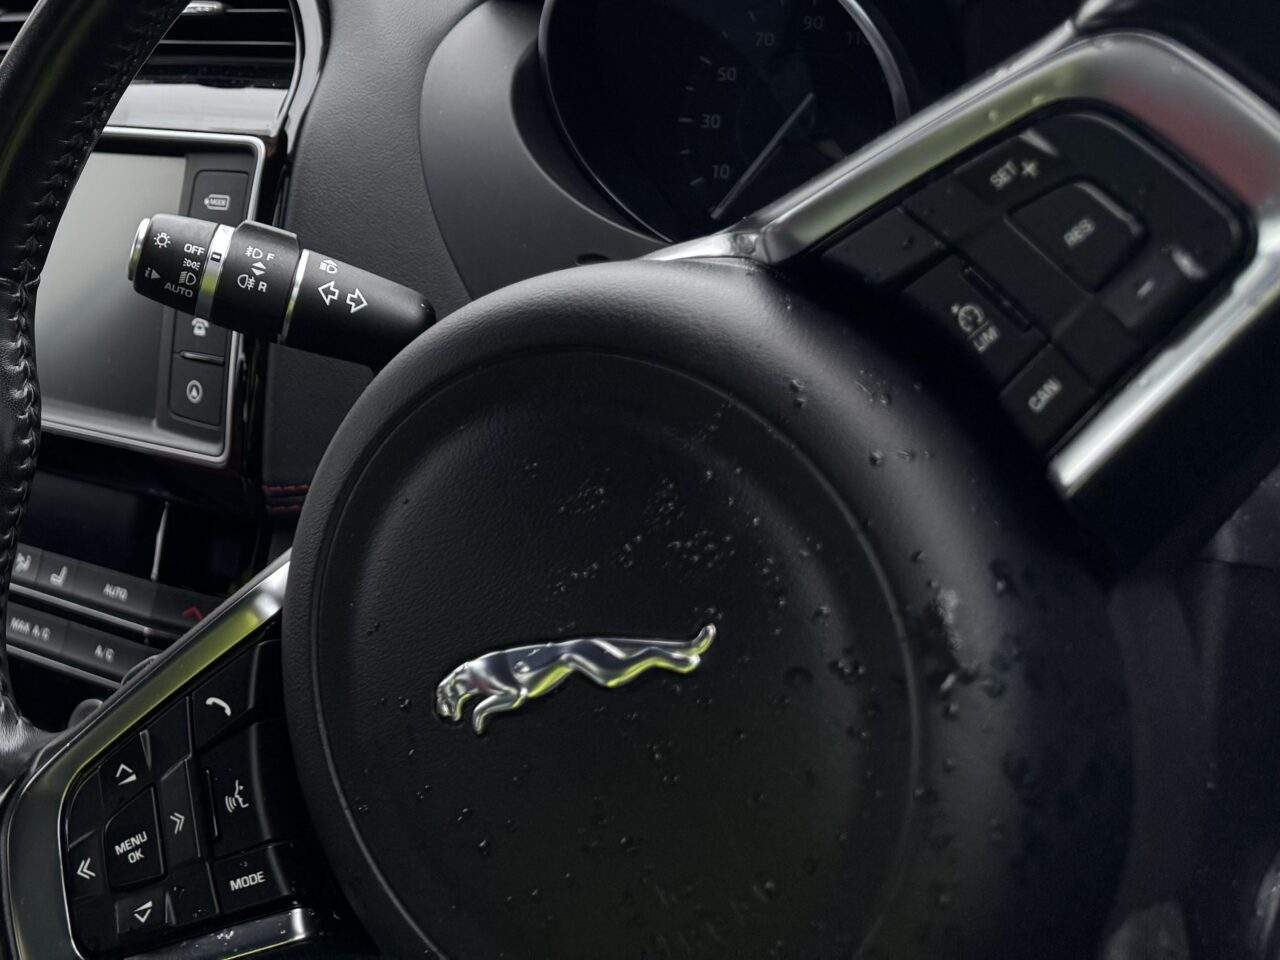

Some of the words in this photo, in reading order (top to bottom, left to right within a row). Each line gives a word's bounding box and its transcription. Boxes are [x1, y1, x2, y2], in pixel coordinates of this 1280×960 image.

[718, 67, 736, 81] 50
[701, 114, 720, 128] 30
[712, 164, 730, 178] 10
[989, 161, 1018, 189] SET
[183, 243, 206, 257] OFF
[266, 253, 275, 261] F
[164, 281, 194, 298] AUTO
[258, 281, 267, 293] R
[1027, 377, 1062, 413] CAN
[103, 583, 129, 601] AUTO
[115, 831, 148, 856] MENU
[128, 849, 145, 864] OK
[230, 870, 265, 891] MODE
